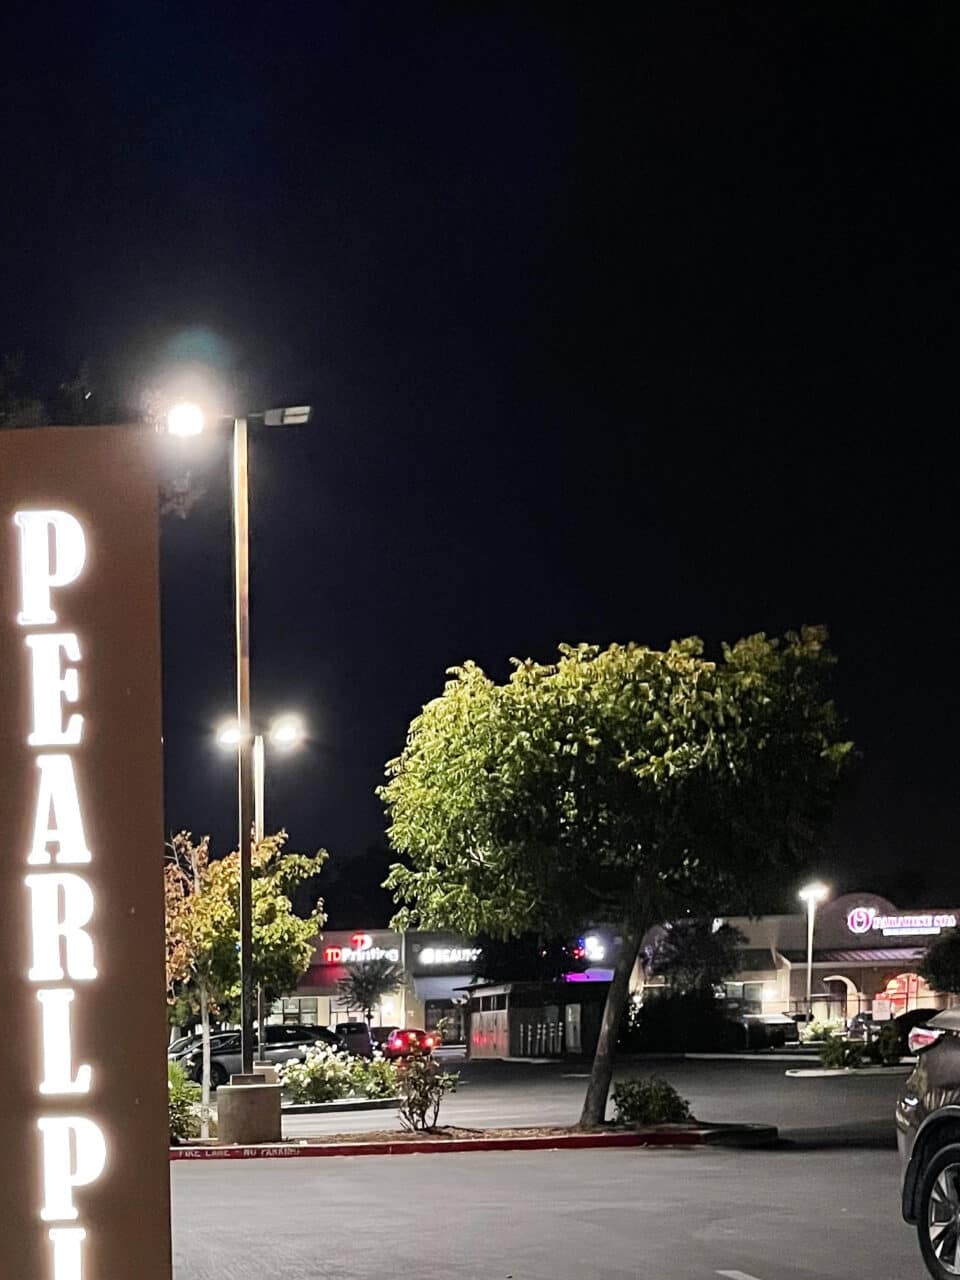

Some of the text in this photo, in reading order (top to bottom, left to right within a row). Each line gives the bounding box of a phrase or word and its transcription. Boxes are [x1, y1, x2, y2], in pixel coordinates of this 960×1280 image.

[12, 509, 98, 1095] PEARL
[205, 1149, 231, 1157] LANE
[243, 1148, 257, 1156] NO
[260, 1147, 301, 1156] PARKING
